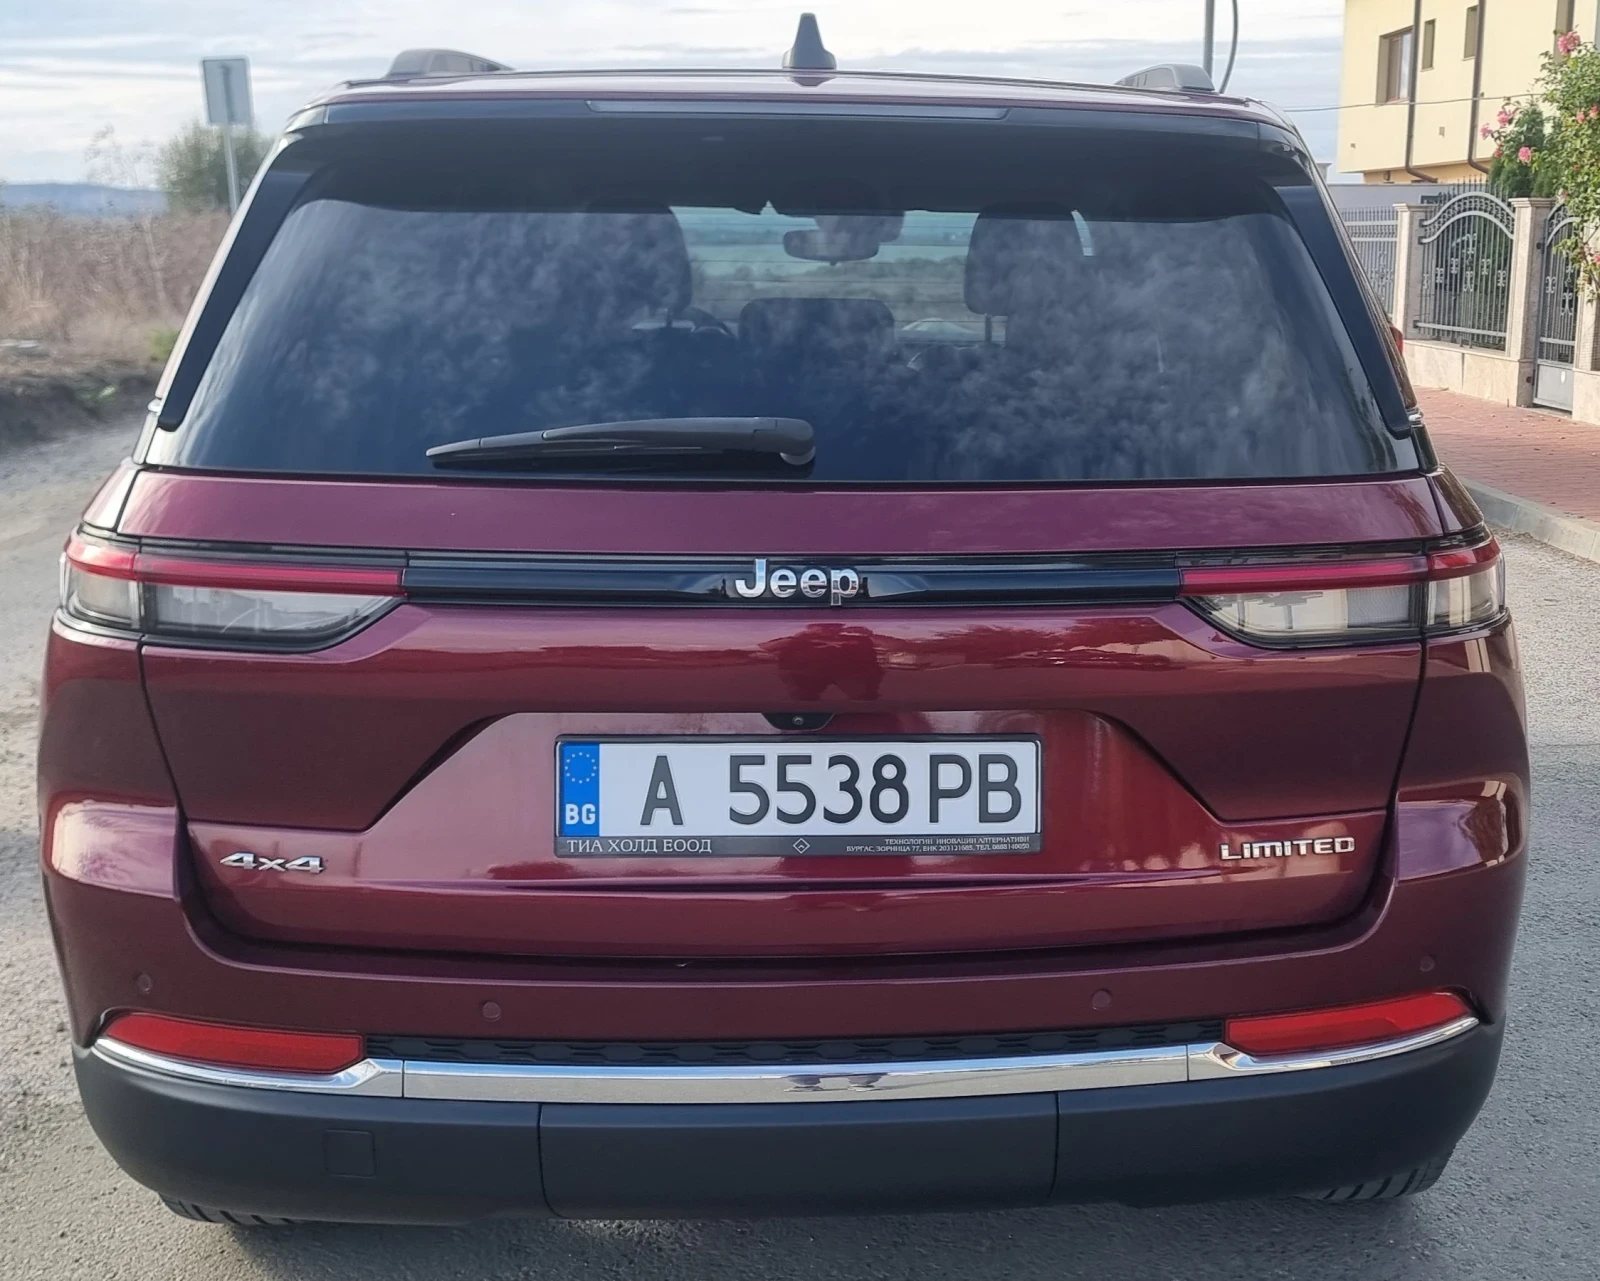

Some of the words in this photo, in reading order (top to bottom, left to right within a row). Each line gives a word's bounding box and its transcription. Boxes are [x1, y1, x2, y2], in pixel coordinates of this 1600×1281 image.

[735, 558, 859, 606] Jeep
[729, 754, 909, 825] 5538
[565, 803, 596, 825] BG
[566, 839, 603, 853] ТИА
[607, 839, 657, 853] ХОЛД
[663, 839, 712, 853] ЕООД
[1220, 837, 1355, 859] LIMITED
[219, 852, 325, 873] 4x4
